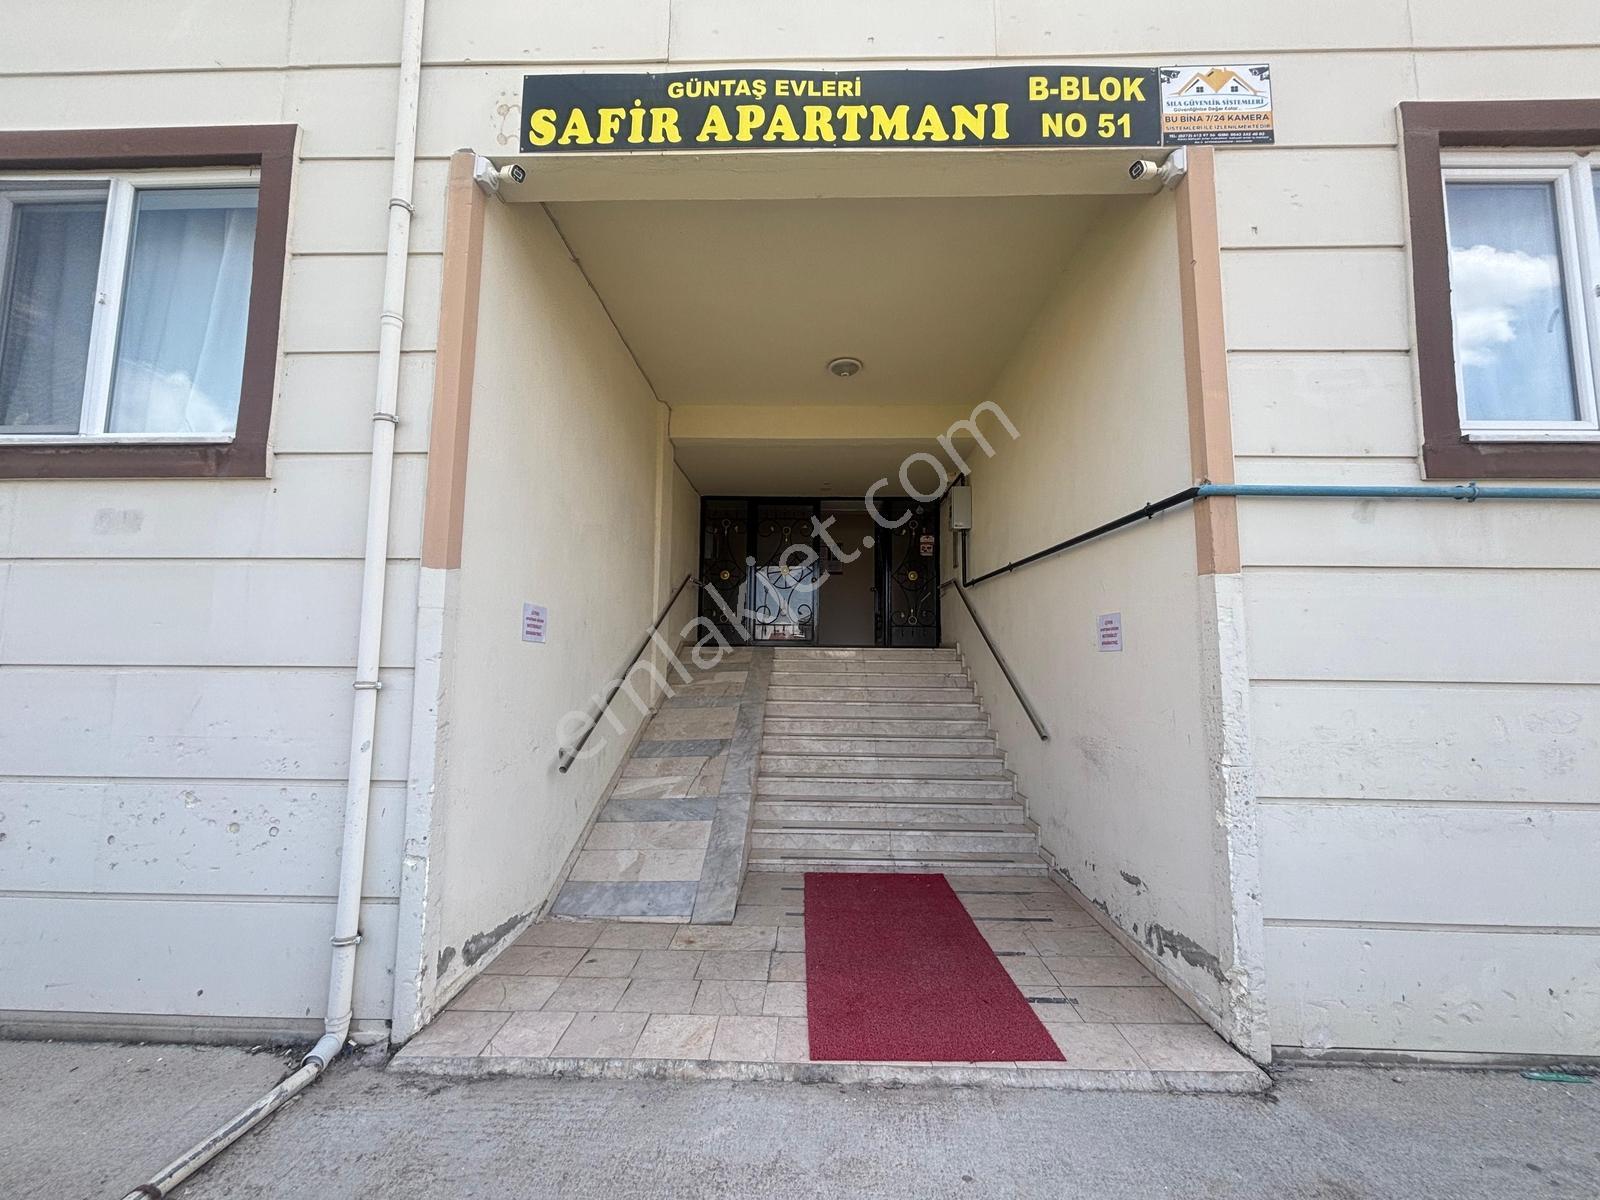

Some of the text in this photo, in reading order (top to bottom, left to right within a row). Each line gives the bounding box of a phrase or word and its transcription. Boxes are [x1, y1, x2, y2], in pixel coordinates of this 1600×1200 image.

[667, 77, 862, 100] GÜNTAŞ EVLERİ
[1028, 76, 1147, 102] B-BLOK
[528, 98, 1010, 146] SAFİR APARTMANI
[1041, 112, 1131, 138] NO 51
[1165, 113, 1270, 123] BU BİNA 7/24 KAMERA
